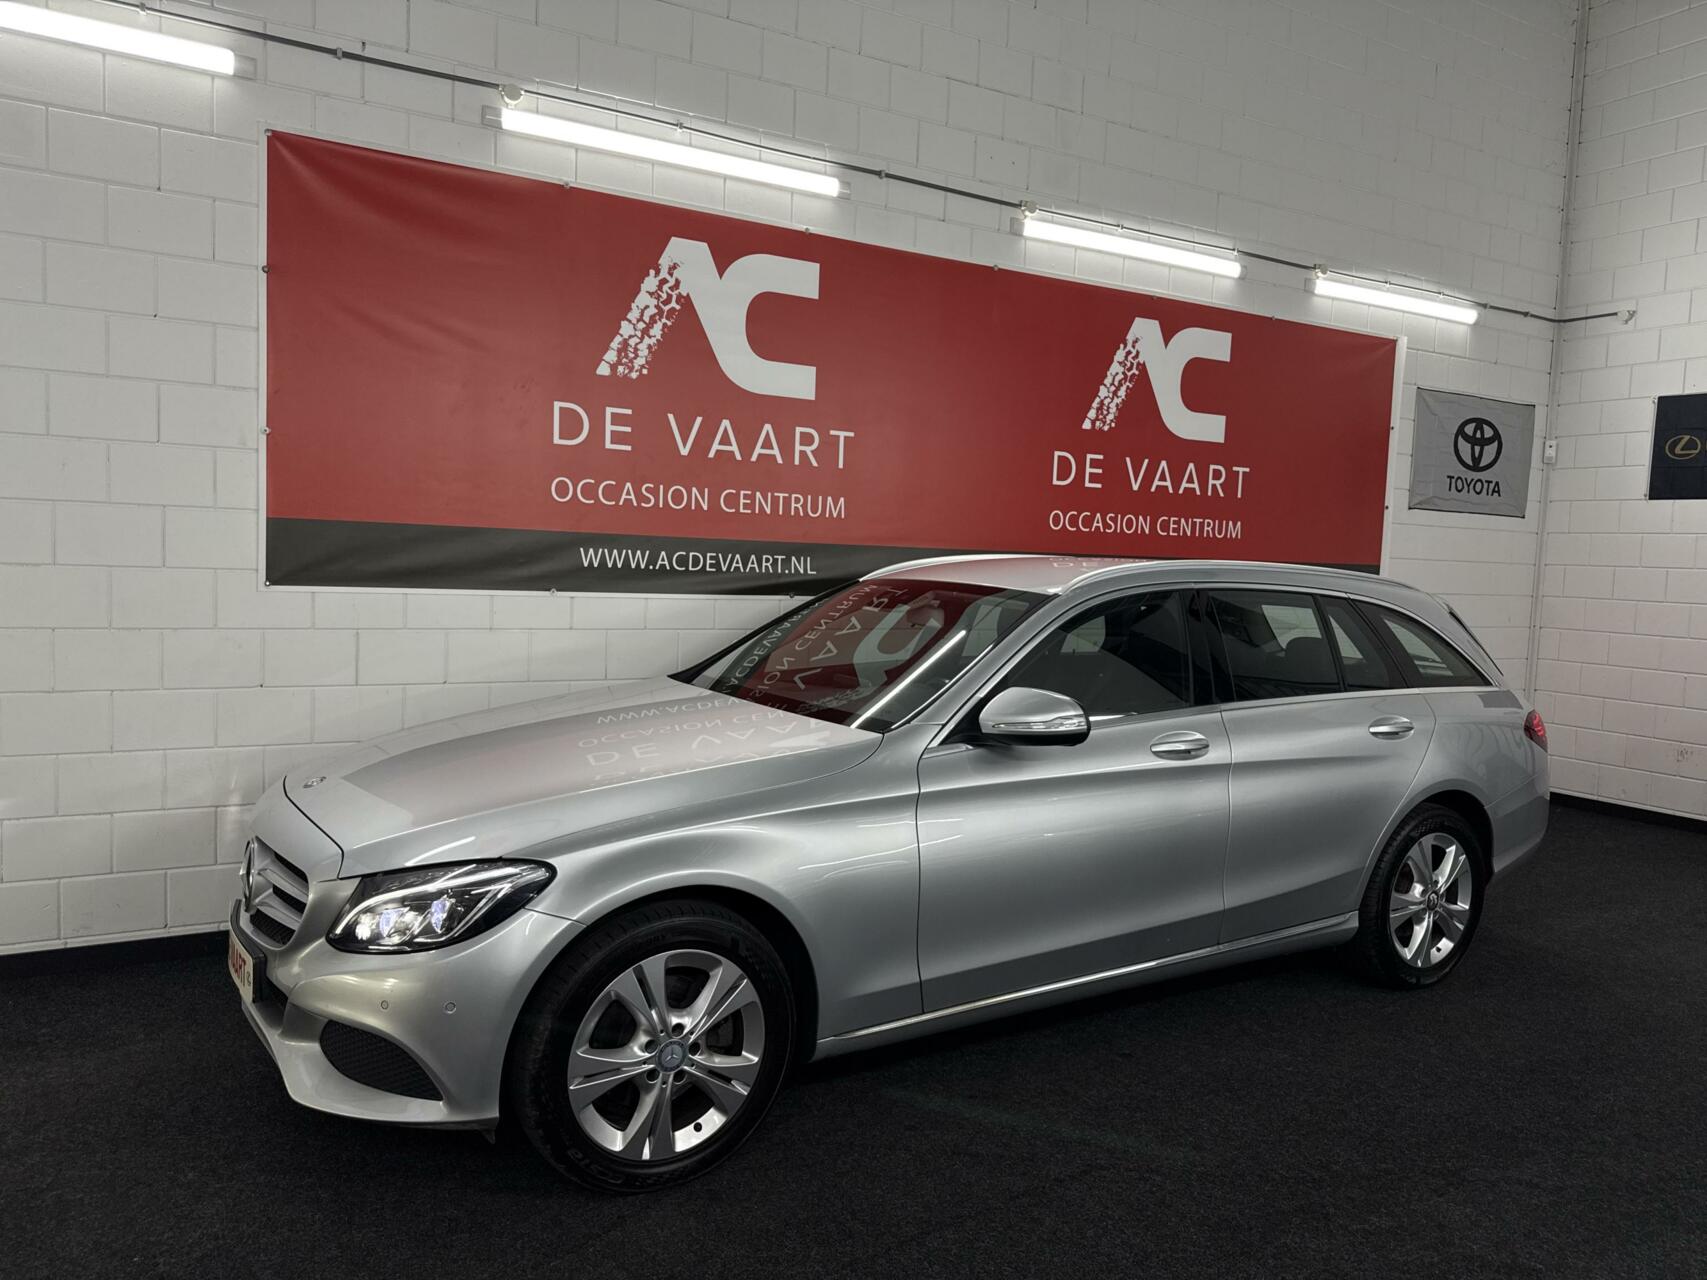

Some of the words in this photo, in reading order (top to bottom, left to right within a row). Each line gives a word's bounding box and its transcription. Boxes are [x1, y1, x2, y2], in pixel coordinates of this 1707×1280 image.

[552, 400, 633, 452] DE
[667, 412, 855, 469] VAART
[1052, 450, 1104, 489] DE
[1125, 456, 1250, 499] VAART
[1446, 474, 1502, 498] TOYOTA
[550, 476, 709, 511] OCCASION
[719, 489, 846, 519] CENTRUM
[1049, 510, 1150, 535] OCCASION
[1156, 516, 1242, 540] CENTRUM
[579, 547, 817, 575] WWW.ACDEVAART.NL
